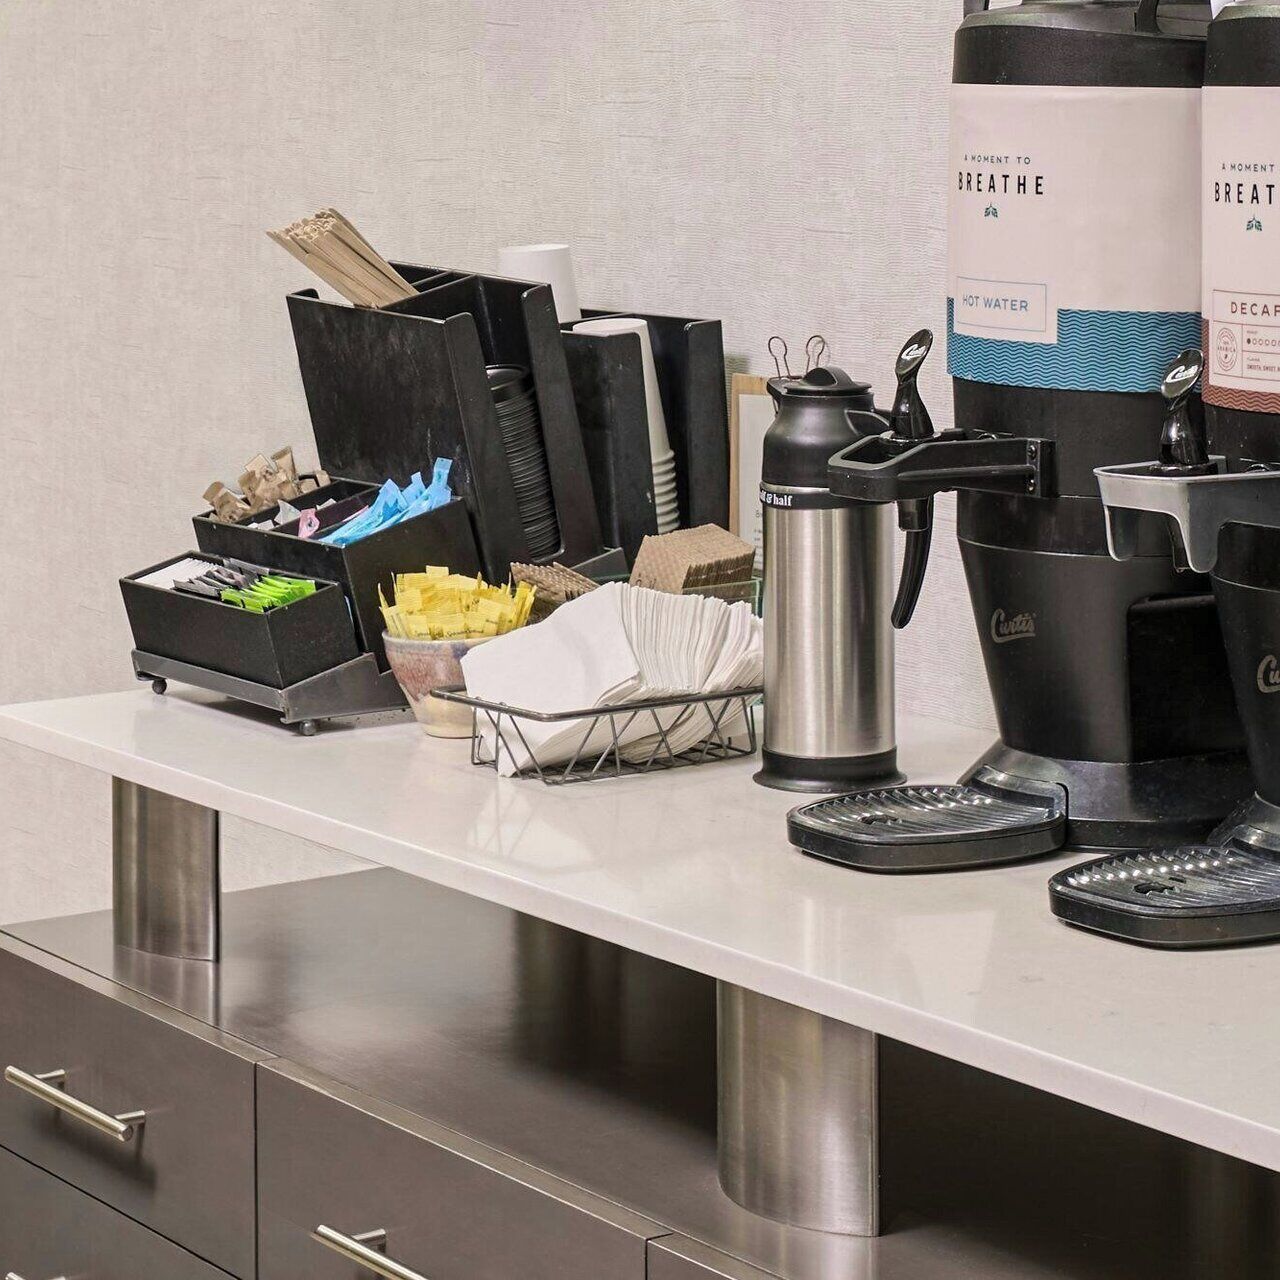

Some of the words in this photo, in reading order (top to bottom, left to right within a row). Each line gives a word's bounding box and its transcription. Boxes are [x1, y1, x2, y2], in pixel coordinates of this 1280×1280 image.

[963, 154, 969, 162] A
[970, 155, 1010, 165] MOMENT
[1016, 156, 1032, 166] TO
[1221, 163, 1227, 171] A
[1230, 163, 1275, 173] MOMENT
[958, 171, 1045, 196] BREATHE
[962, 294, 980, 308] HOT
[983, 297, 1030, 313] WATER
[773, 493, 794, 507] half
[990, 607, 1037, 644] Curtis
